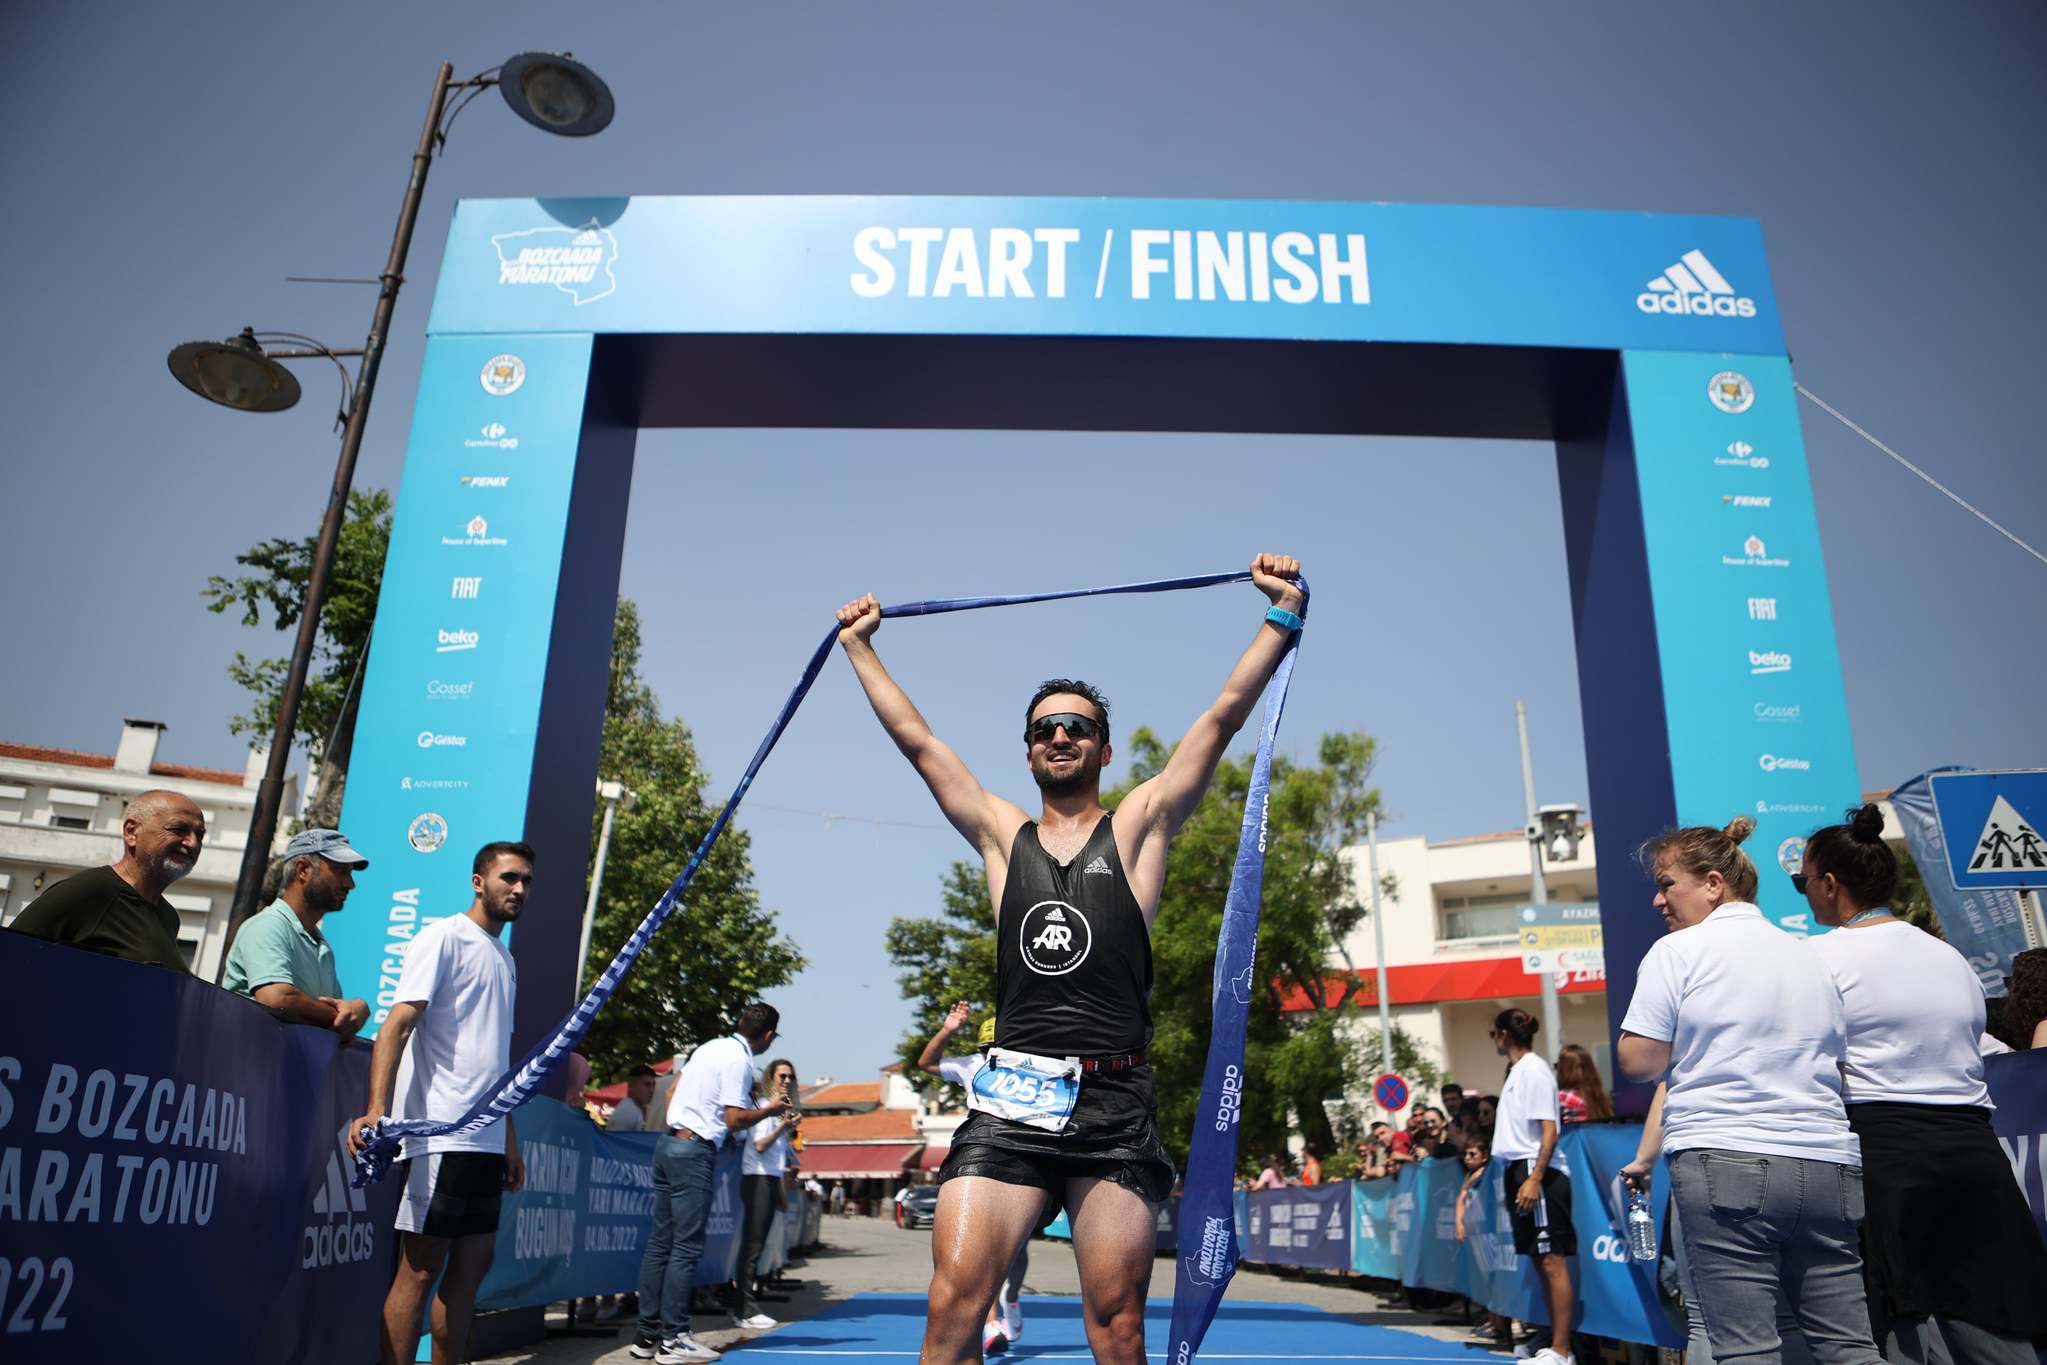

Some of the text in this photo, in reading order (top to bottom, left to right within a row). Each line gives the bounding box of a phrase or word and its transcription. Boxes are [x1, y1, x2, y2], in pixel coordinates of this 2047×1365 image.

[517, 247, 603, 265] BOZCAADA
[850, 226, 1080, 298] START
[1130, 229, 1371, 305] FINISH
[499, 264, 597, 284] MARATONU
[1636, 289, 1757, 318] adidas
[452, 577, 482, 599] FIAT
[438, 629, 479, 644] beko
[1748, 650, 1791, 666] beko
[1032, 924, 1072, 952] AR
[988, 1071, 1057, 1107] 1055
[1215, 1064, 1239, 1132] adidas
[35, 1063, 246, 1155] BOZCAADA
[302, 1212, 374, 1269] adidas
[1199, 1215, 1218, 1277] MARATONU
[1210, 1229, 1230, 1279] BOZCAADA
